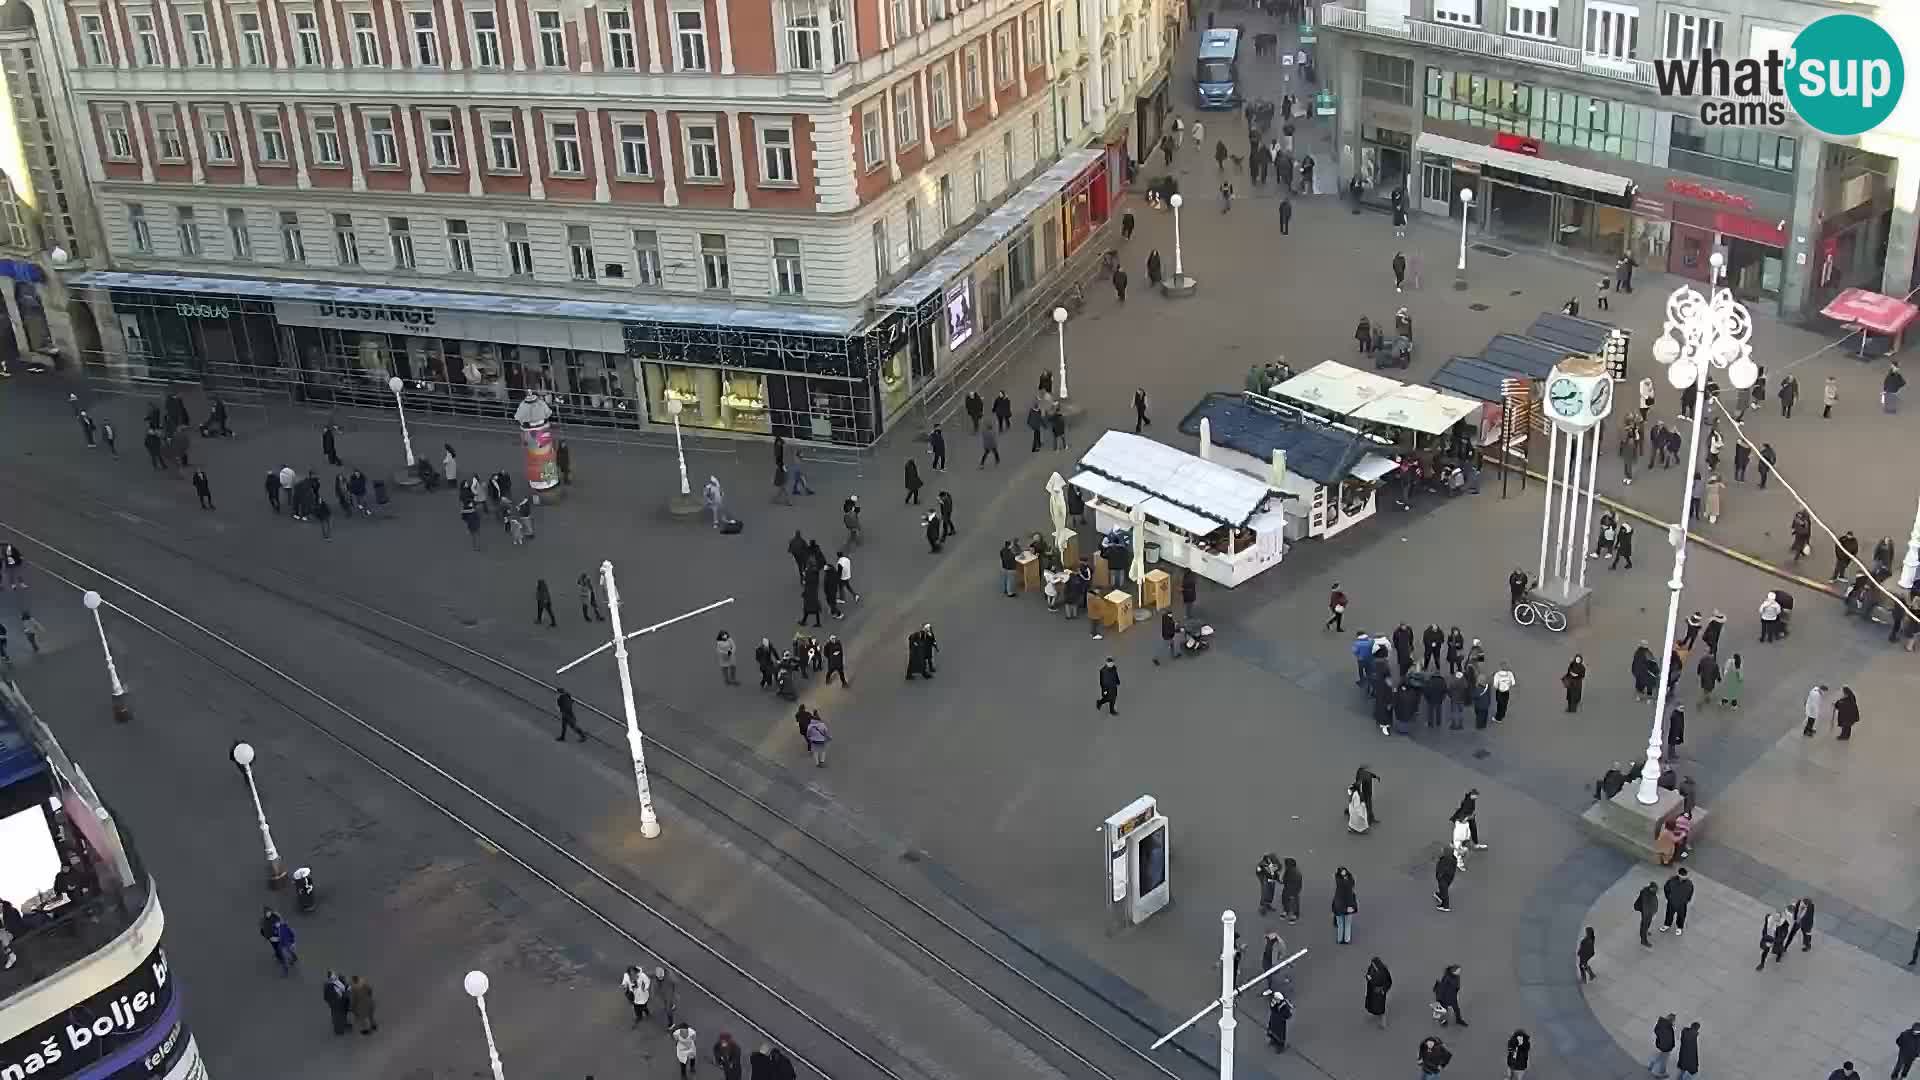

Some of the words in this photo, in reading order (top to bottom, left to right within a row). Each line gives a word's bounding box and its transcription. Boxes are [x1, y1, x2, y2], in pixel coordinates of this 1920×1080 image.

[176, 303, 230, 319] DOUGLAS
[320, 303, 437, 325] DESSANGE
[1, 1035, 62, 1080] naš
[66, 991, 156, 1051] bolje,
